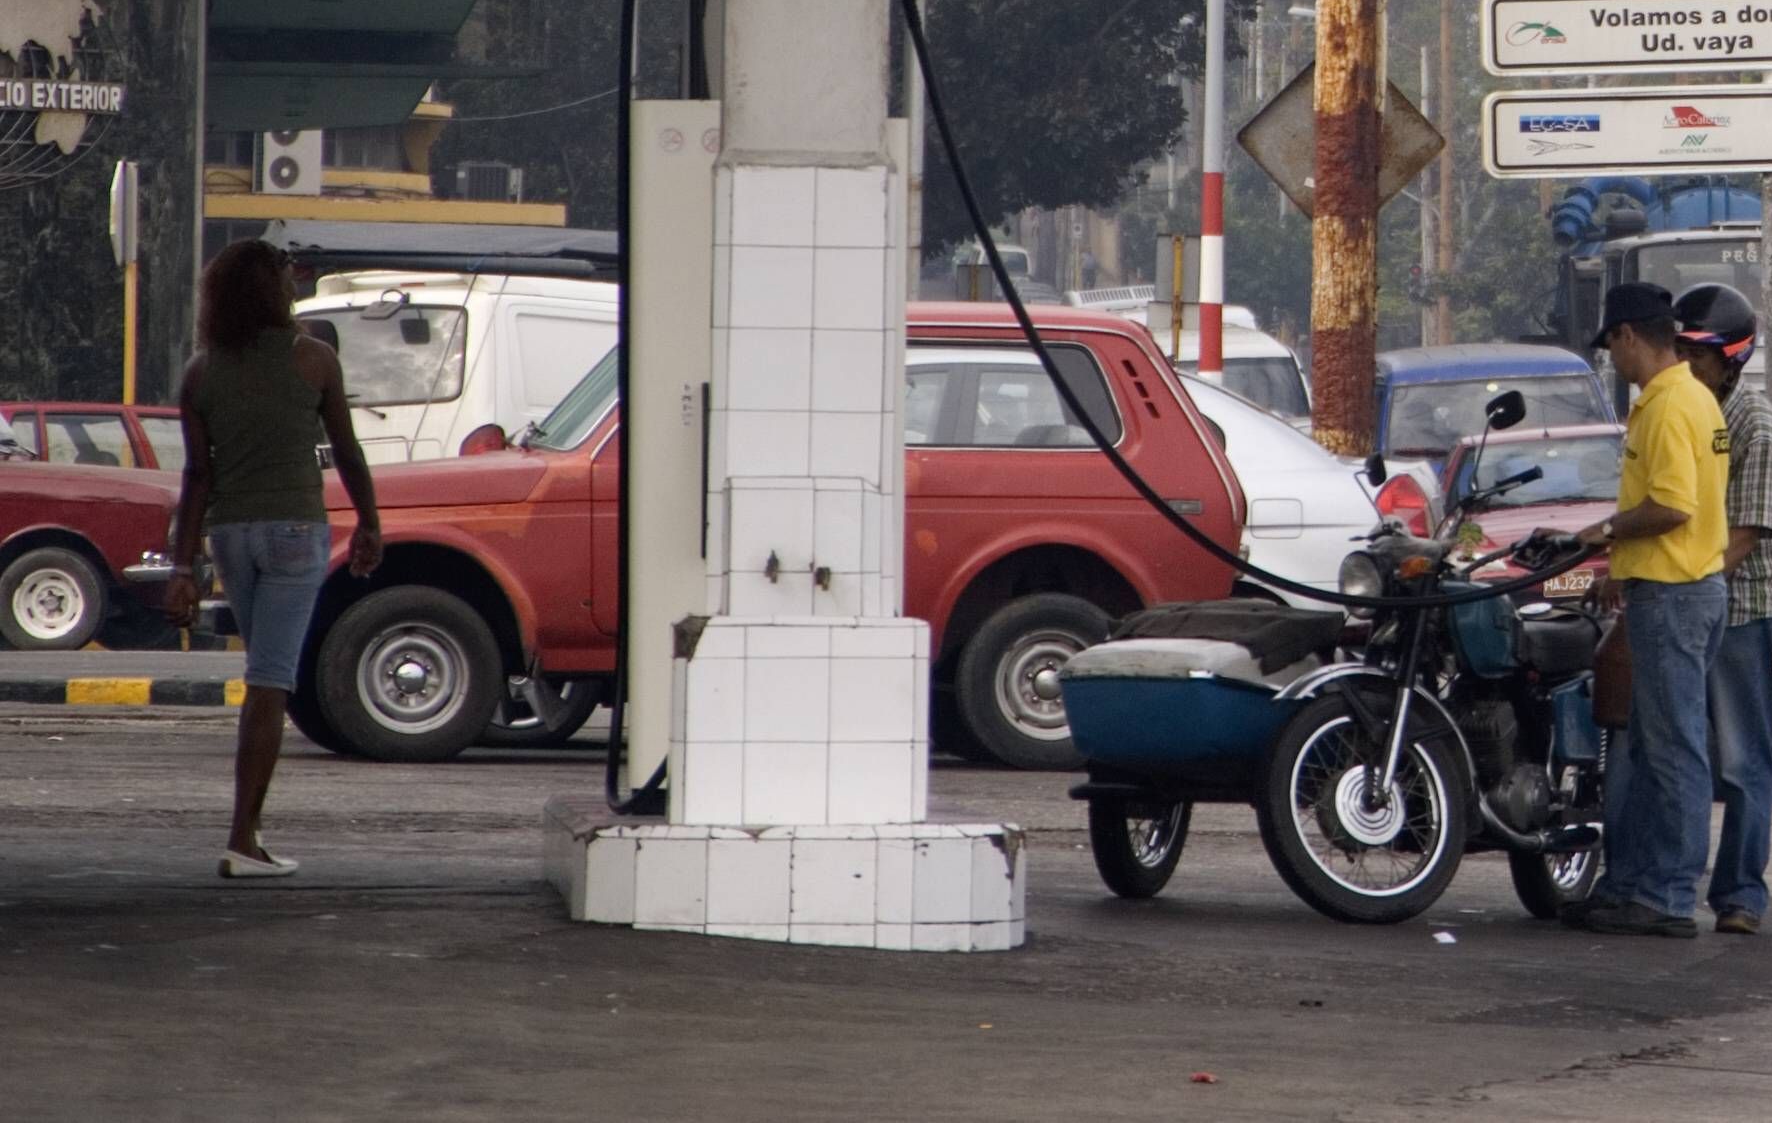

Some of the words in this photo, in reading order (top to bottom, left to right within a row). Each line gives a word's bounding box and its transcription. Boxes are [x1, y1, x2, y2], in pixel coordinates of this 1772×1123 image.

[1590, 8, 1702, 27] Volamos
[1711, 10, 1726, 24] a
[1641, 33, 1684, 52] Ud.
[1693, 34, 1753, 54] vaya
[31, 82, 121, 112] EXTERIOR
